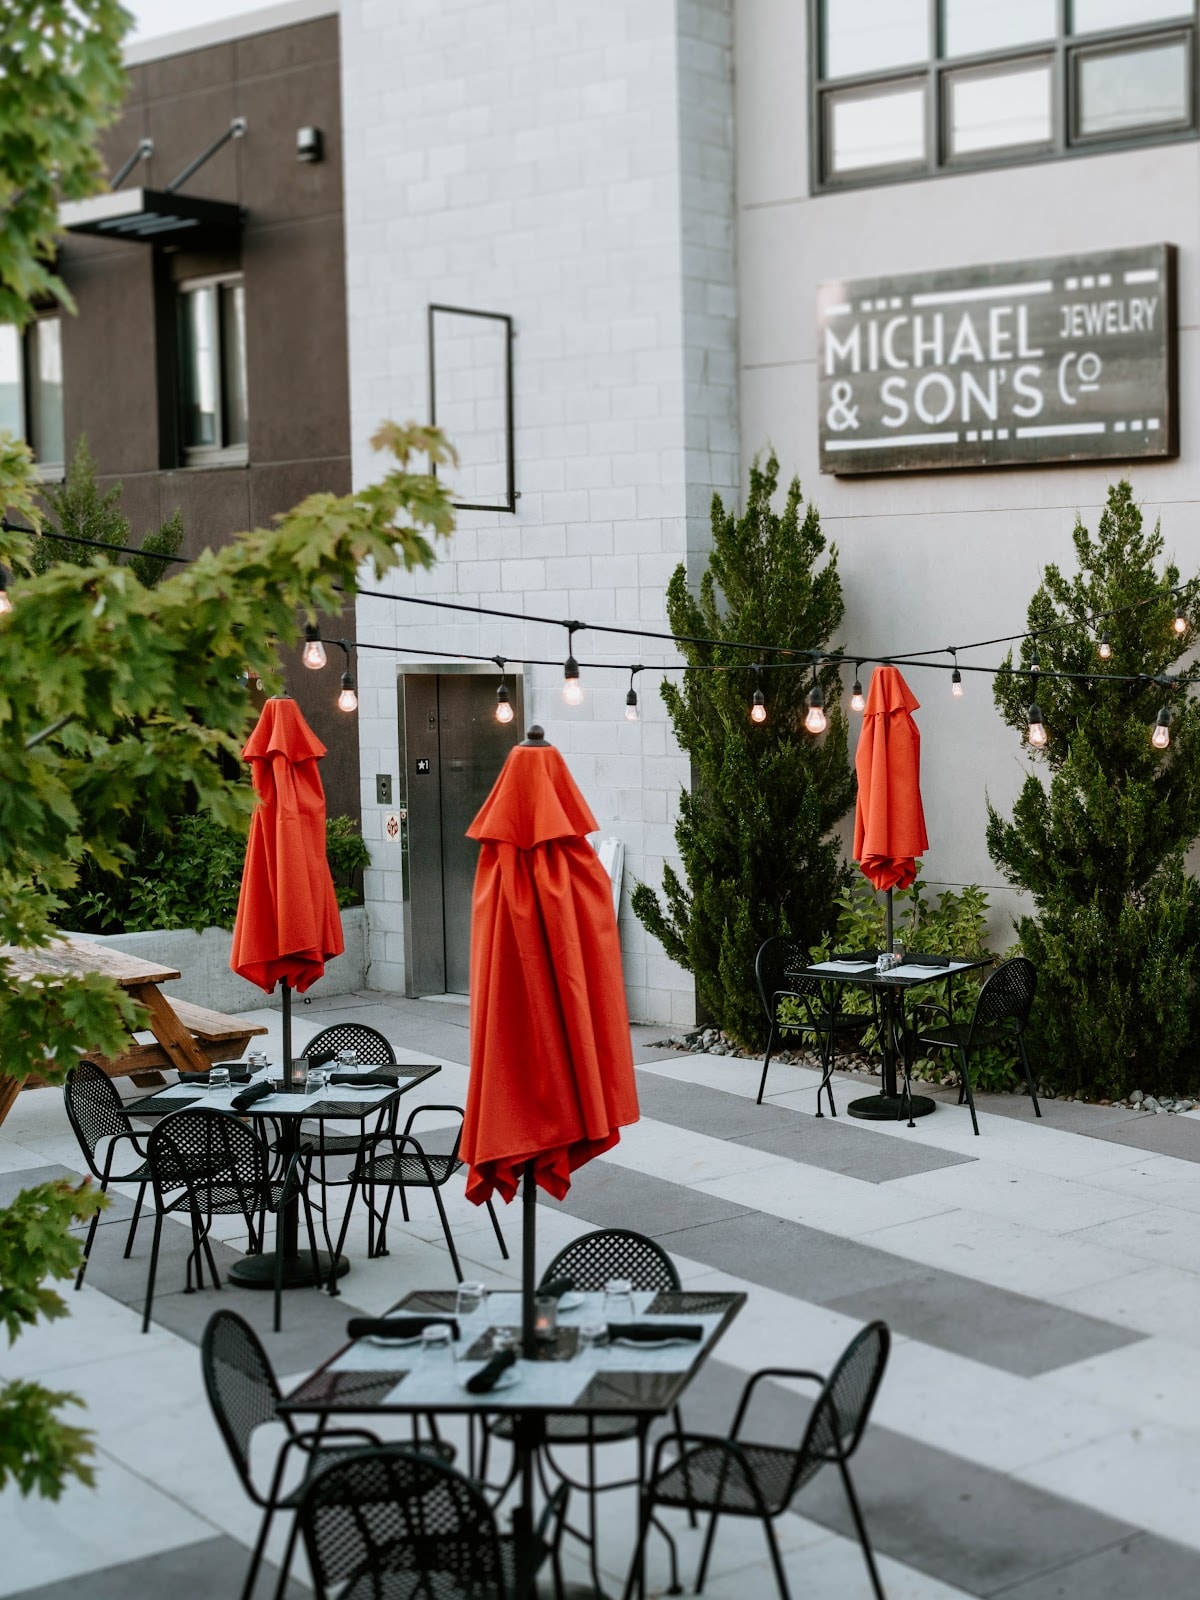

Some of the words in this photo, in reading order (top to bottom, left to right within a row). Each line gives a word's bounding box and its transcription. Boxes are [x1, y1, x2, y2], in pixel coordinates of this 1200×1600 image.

[824, 304, 1044, 376] MICHAEL
[1059, 298, 1158, 338] JEWELRY
[825, 381, 859, 431] &
[880, 365, 1044, 429] SON'S
